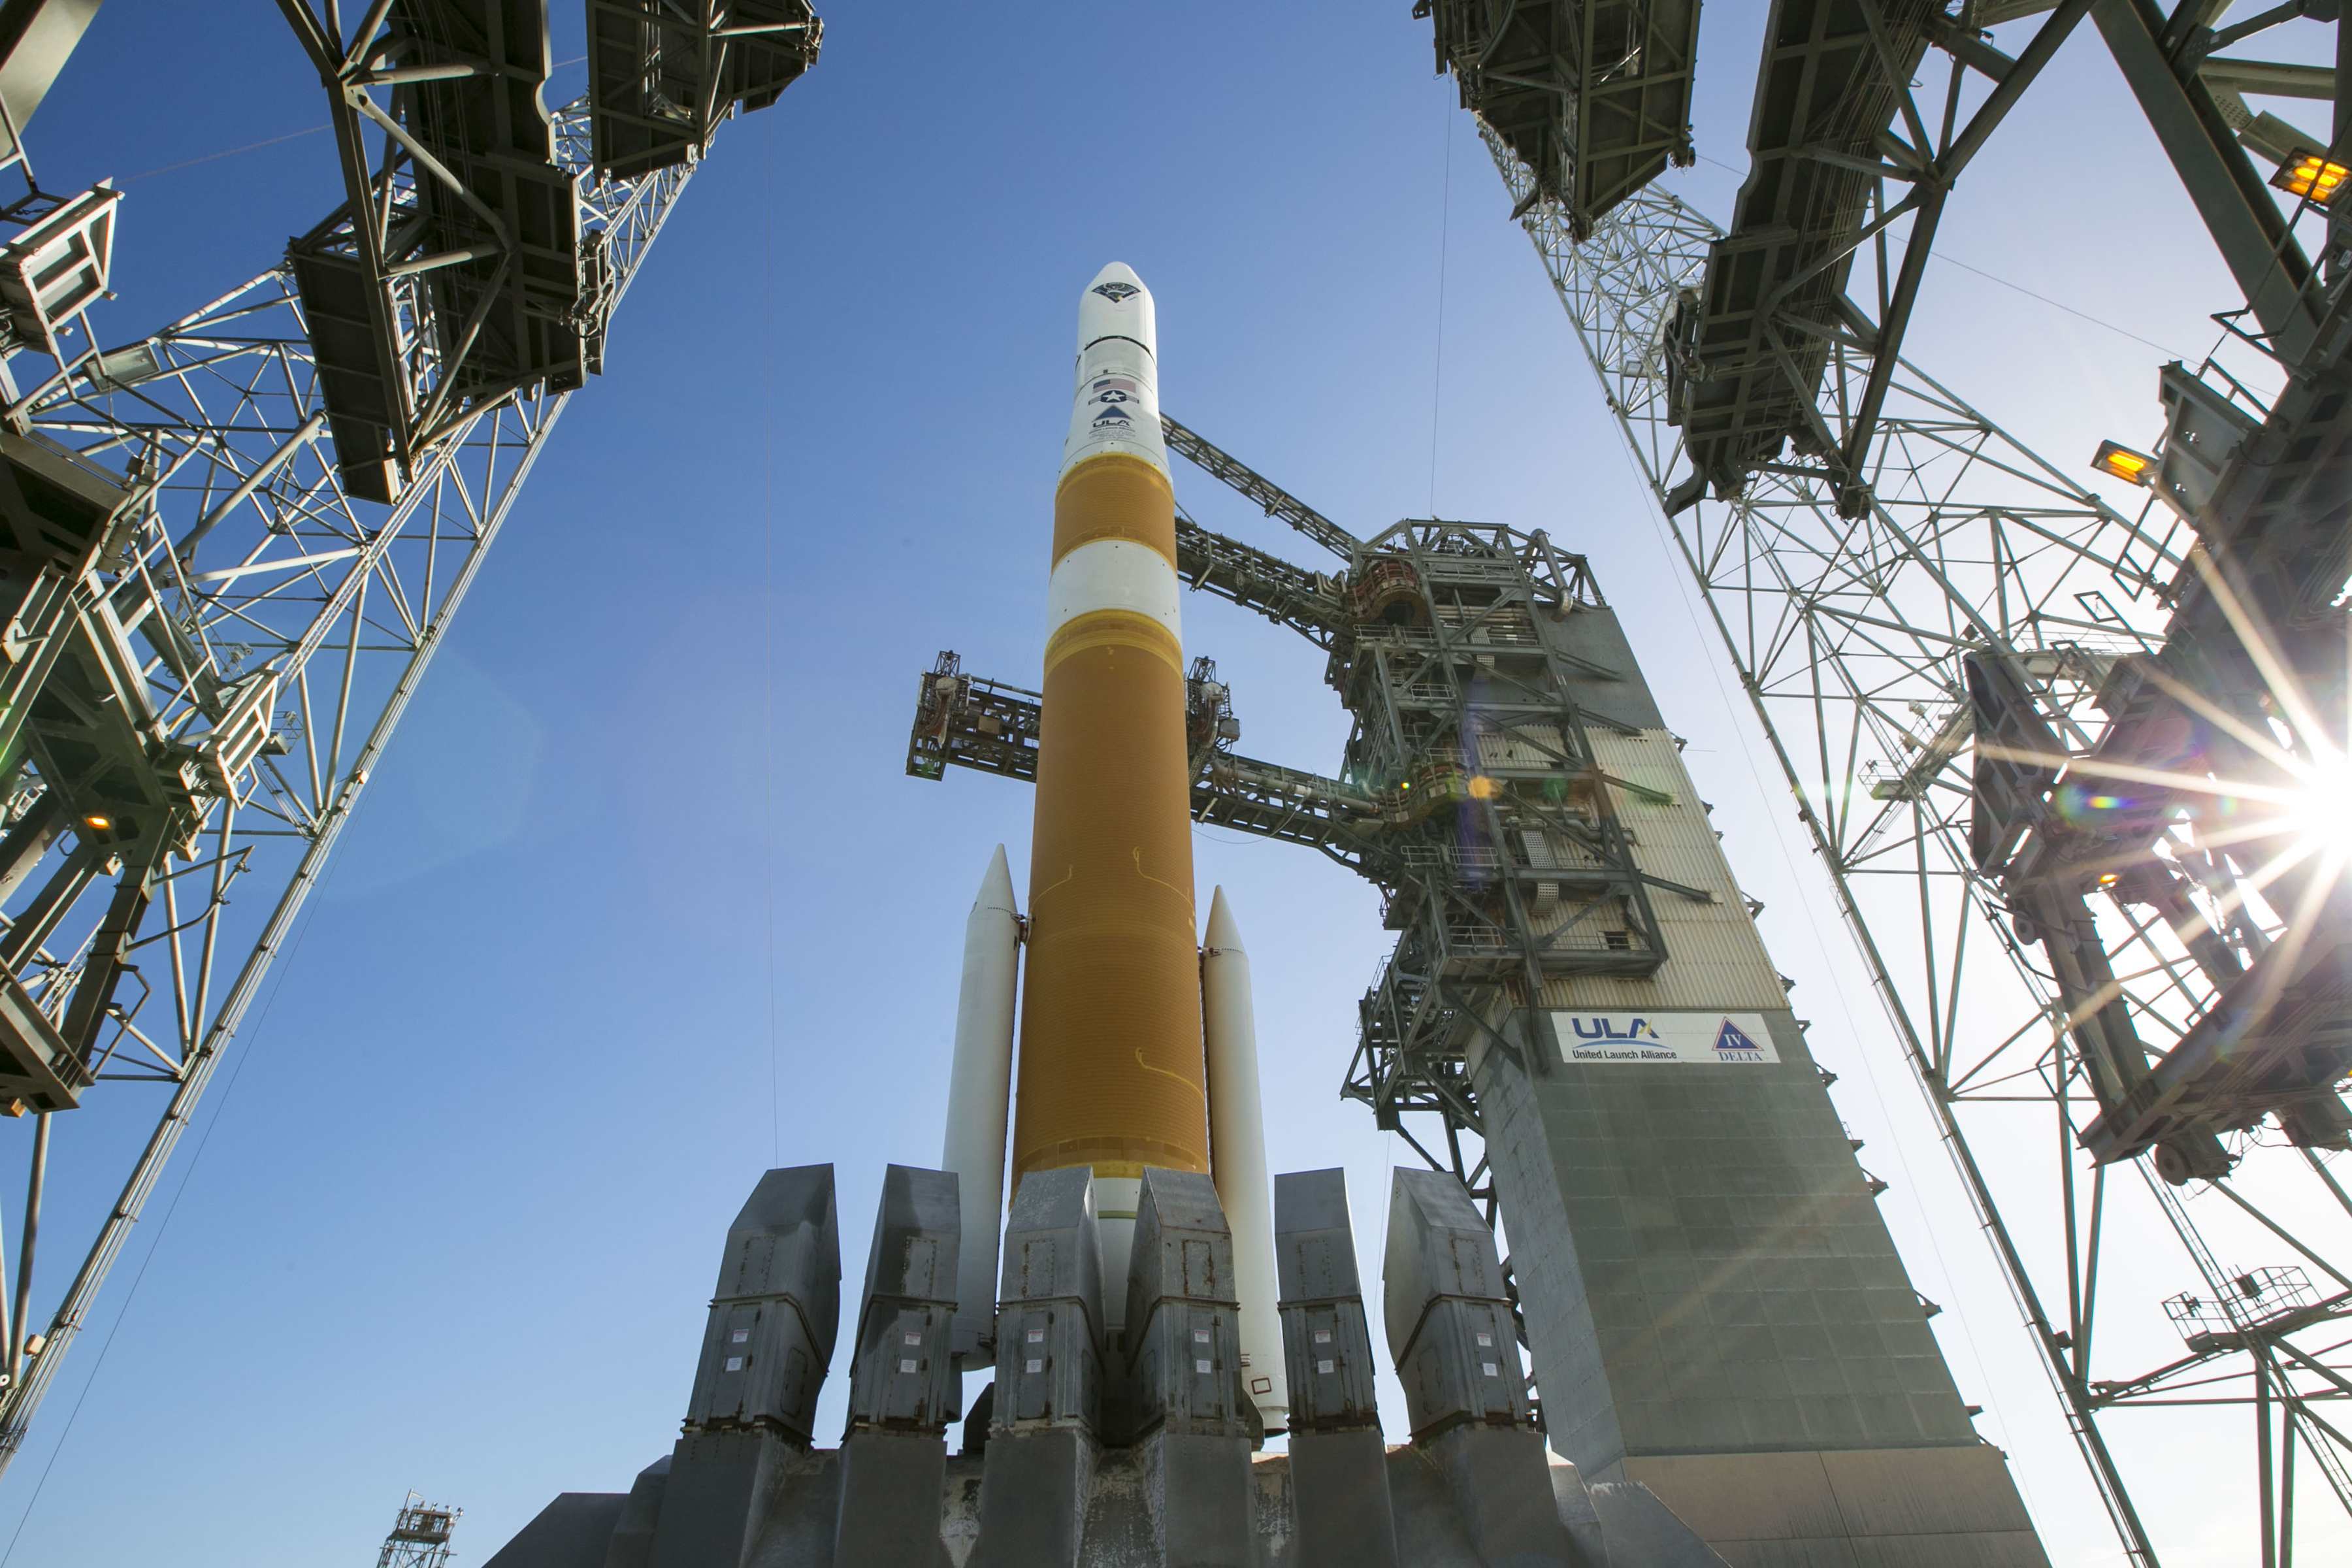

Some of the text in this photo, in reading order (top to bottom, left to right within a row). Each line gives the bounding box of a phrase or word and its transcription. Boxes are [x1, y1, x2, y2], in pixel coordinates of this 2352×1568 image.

[1572, 1017, 1659, 1038] ULA
[1723, 1034, 1741, 1046] IV
[1573, 1050, 1677, 1059] United Launch Alliance
[1718, 1051, 1763, 1061] DELTA
